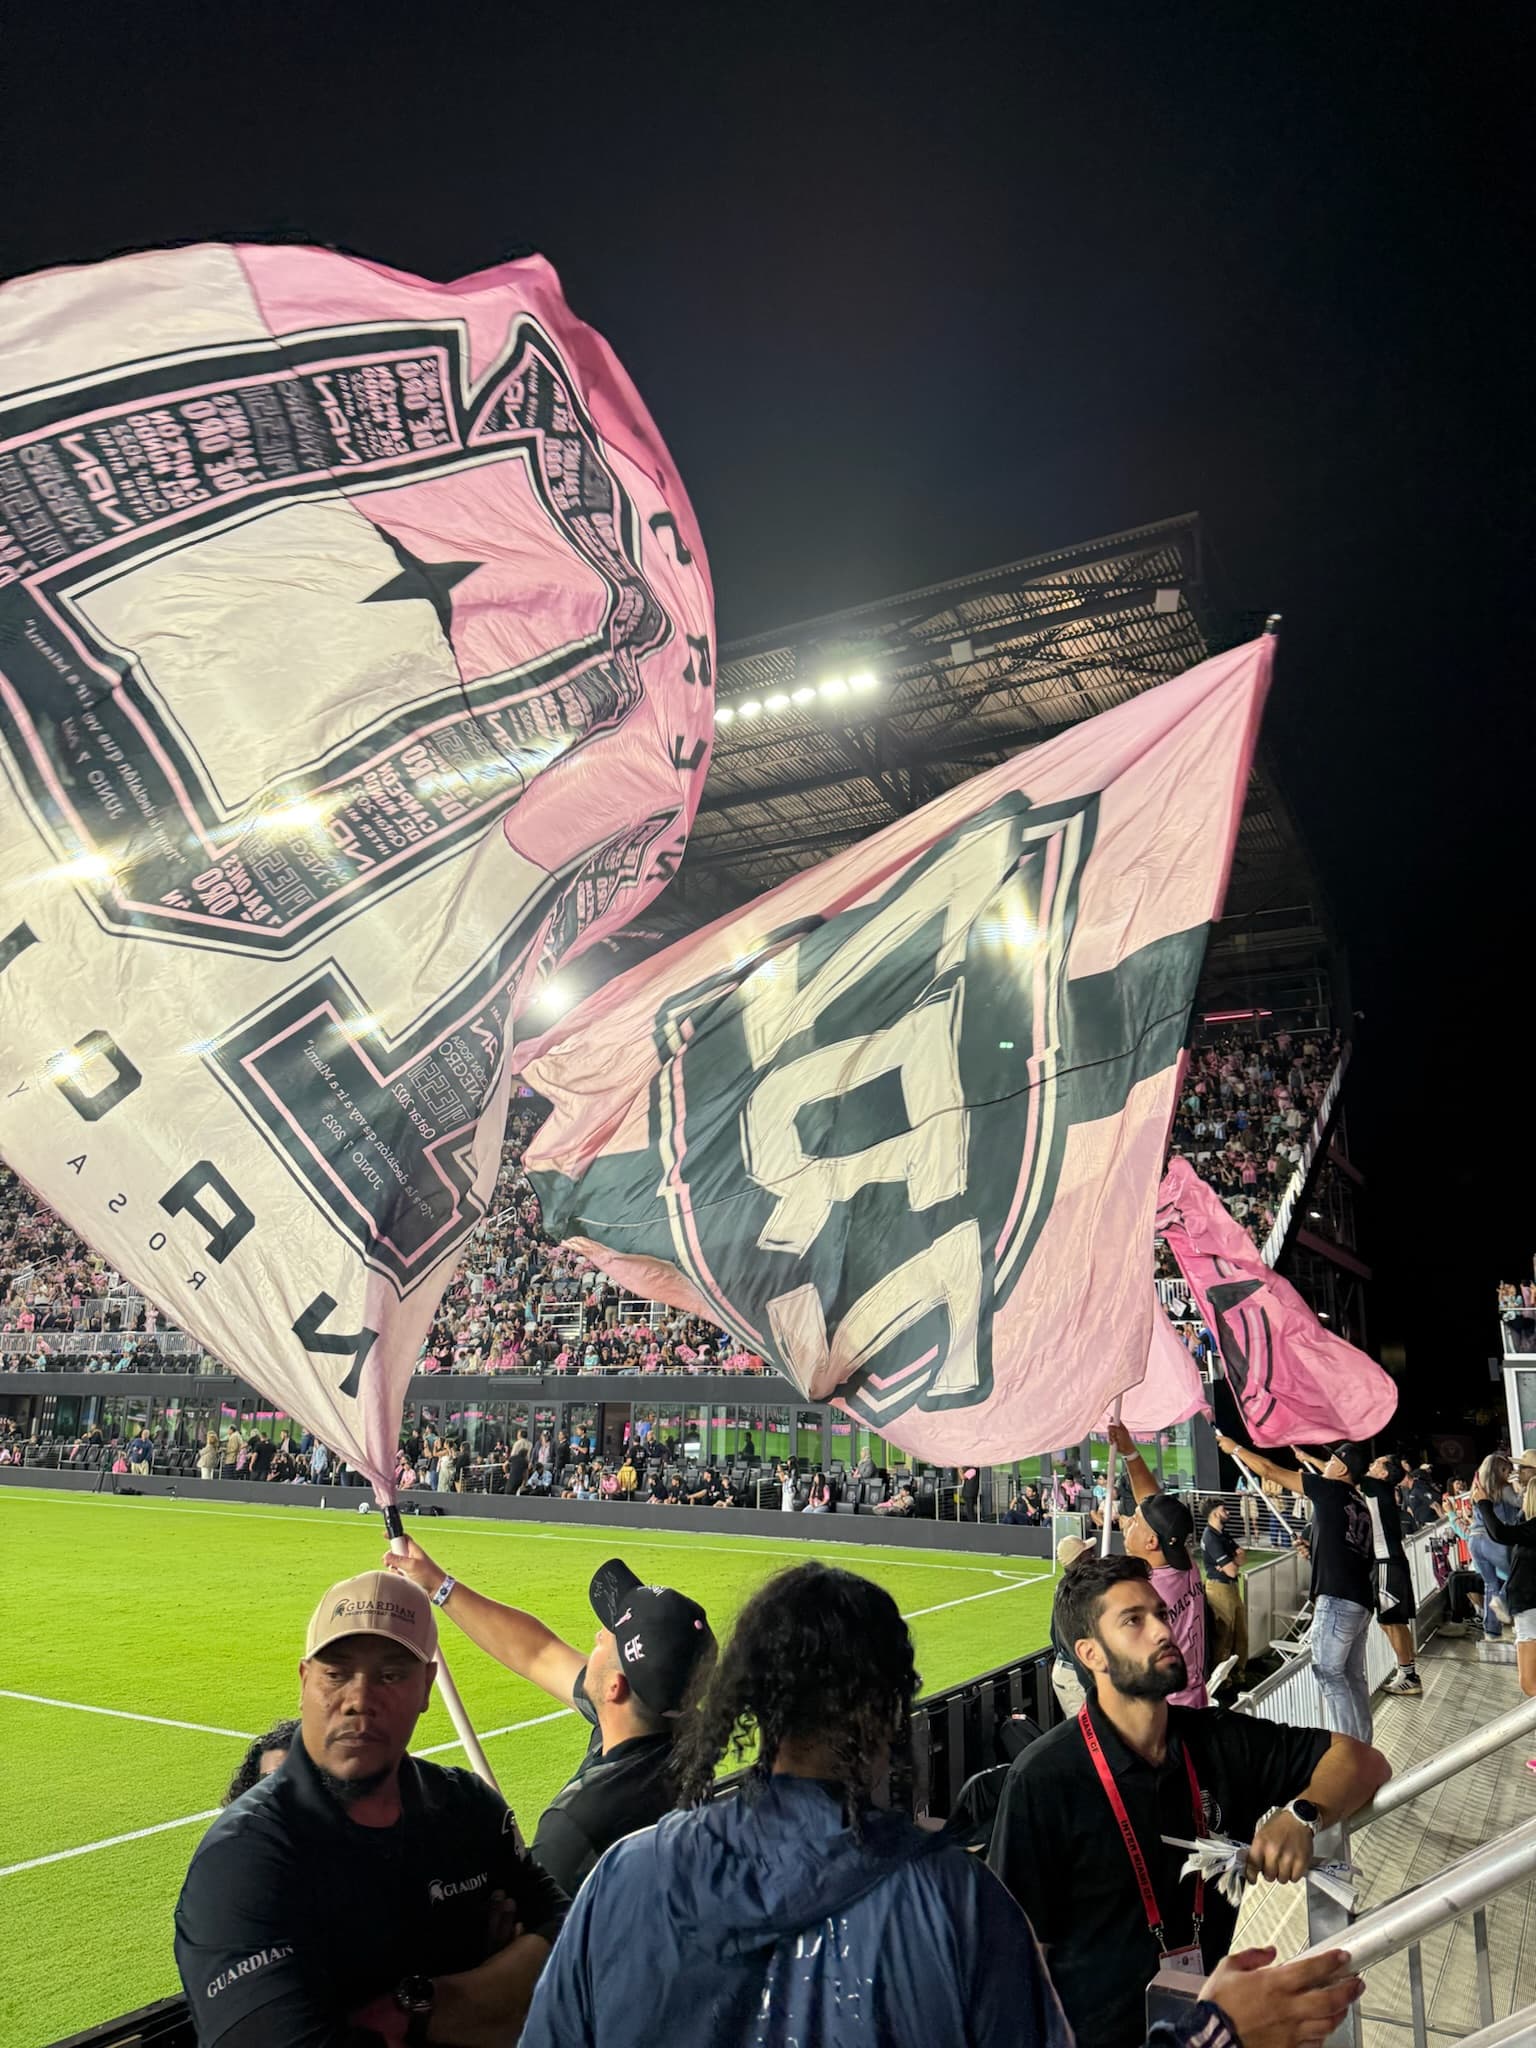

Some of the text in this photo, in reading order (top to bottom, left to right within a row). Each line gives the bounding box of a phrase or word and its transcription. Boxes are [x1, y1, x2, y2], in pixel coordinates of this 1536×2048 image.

[347, 1601, 416, 1618] GUARDIAN
[1081, 1713, 1094, 1743] MIAMI
[207, 1945, 294, 1998] GUARDIAN
